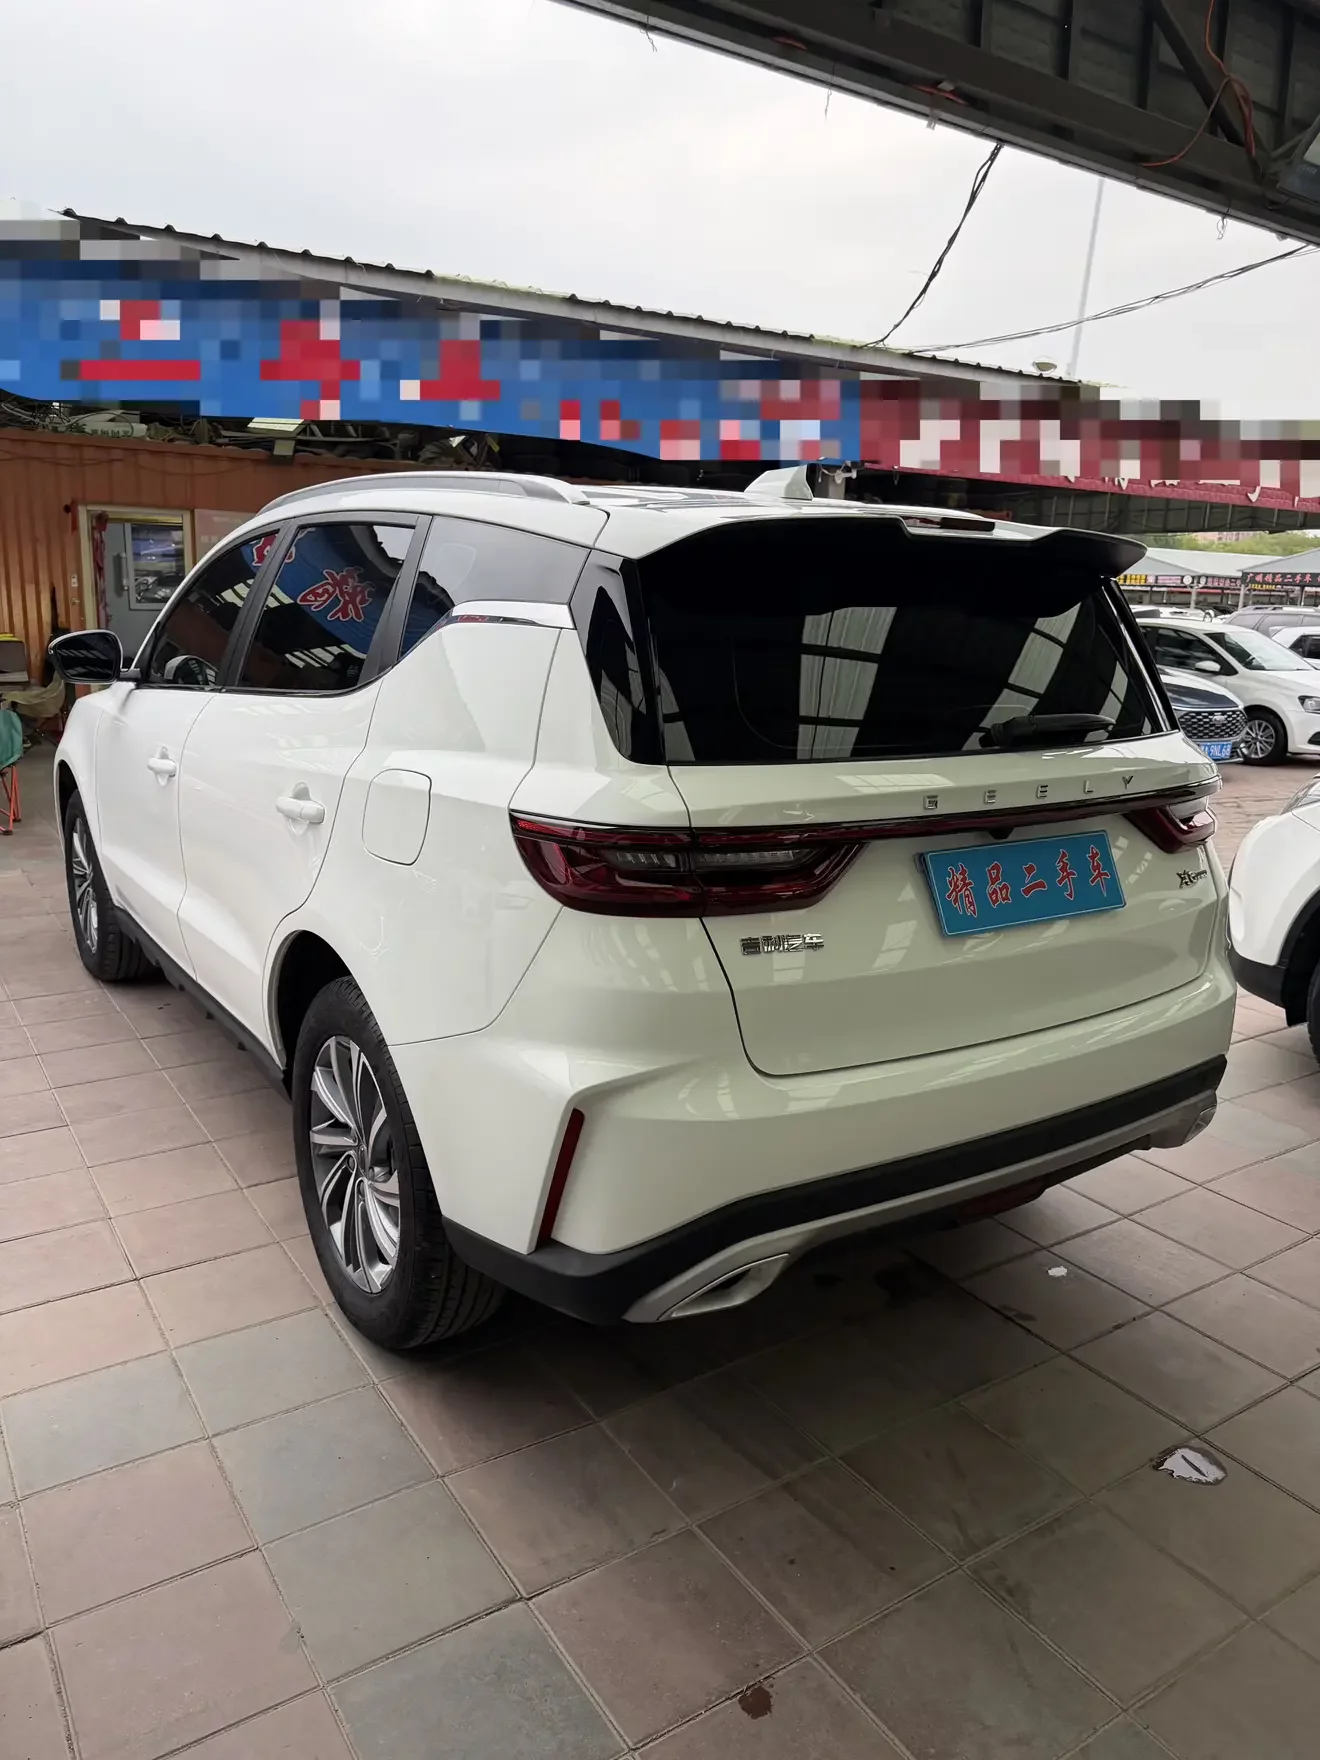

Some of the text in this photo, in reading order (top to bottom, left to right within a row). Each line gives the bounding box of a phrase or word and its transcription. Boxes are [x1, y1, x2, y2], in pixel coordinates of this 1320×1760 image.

[923, 775, 1135, 810] GEELY
[945, 844, 1112, 918] 精品二手车
[739, 932, 825, 956] 吉利汽车
